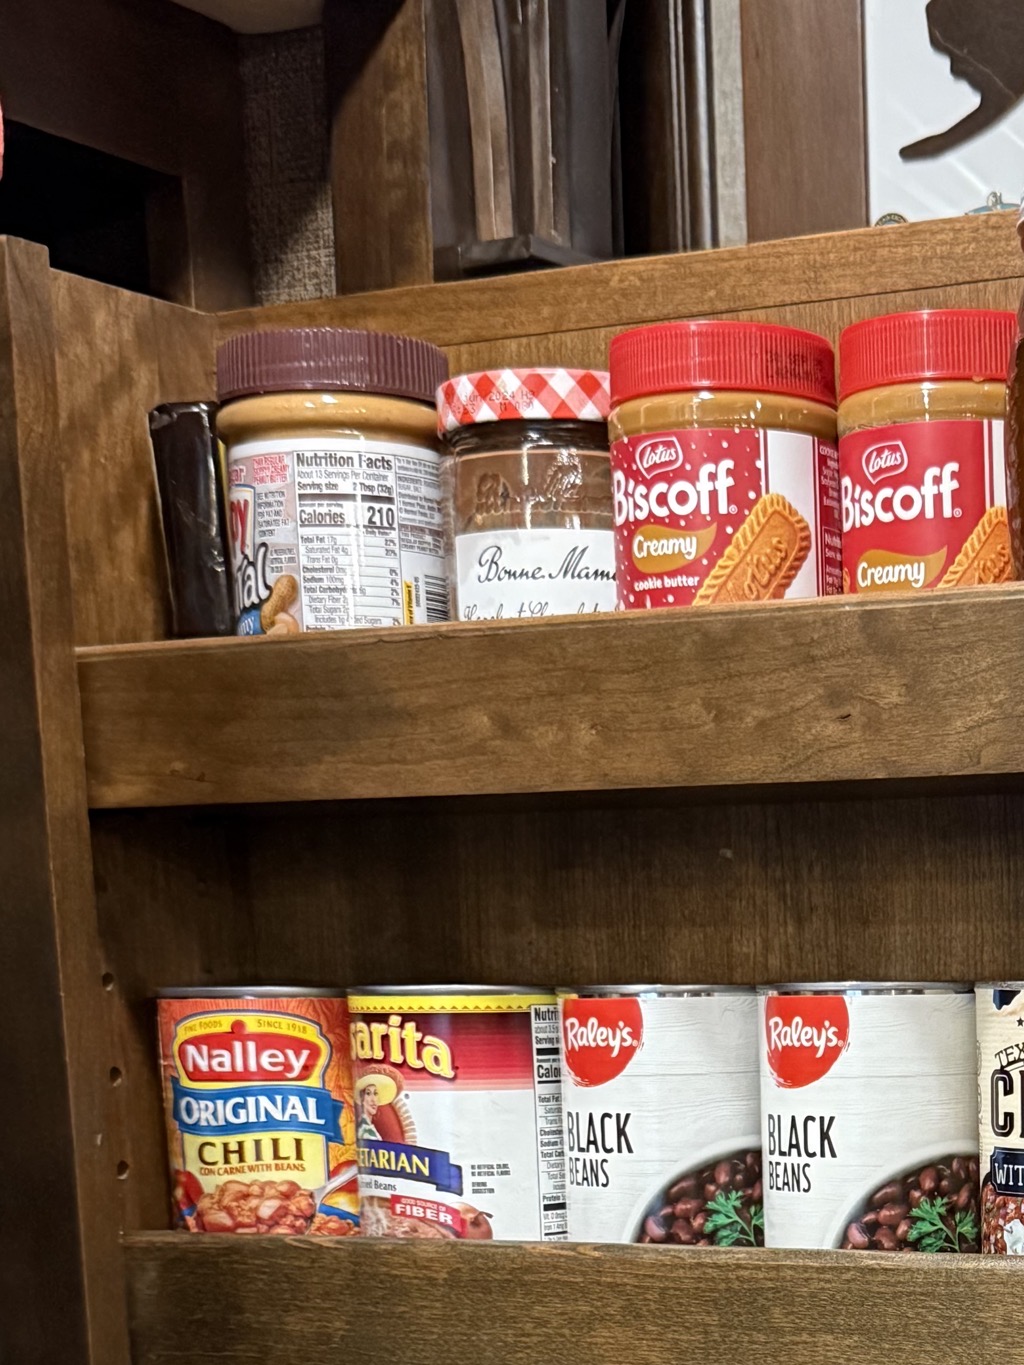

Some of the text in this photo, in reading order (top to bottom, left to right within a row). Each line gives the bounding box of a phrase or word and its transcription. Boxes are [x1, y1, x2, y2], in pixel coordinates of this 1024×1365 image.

[614, 459, 736, 527] Biscoff
[841, 461, 960, 533] Biscoff
[299, 509, 346, 524] Calories
[633, 534, 698, 561] Creamy
[477, 545, 546, 584] Bonne
[857, 560, 925, 588] Creamy
[634, 575, 700, 592] cookie butter
[184, 1020, 223, 1034] FINE FOODS
[257, 1019, 308, 1034] SINCE 1918
[565, 1016, 634, 1059] Raley's
[768, 1015, 840, 1059] Raley's
[183, 1040, 311, 1079] Nalley
[351, 1015, 456, 1080] arita
[180, 1094, 326, 1127] ORIGINAL
[566, 1111, 635, 1155] BLACK
[767, 1113, 838, 1159] BLACK
[198, 1137, 306, 1167] CHILI
[200, 1162, 306, 1176] CON CARNE WITH BEANS
[569, 1156, 610, 1188] BEANS
[768, 1160, 812, 1194] BEANS
[374, 1179, 398, 1192] Beans
[393, 1203, 454, 1225] FIBER
